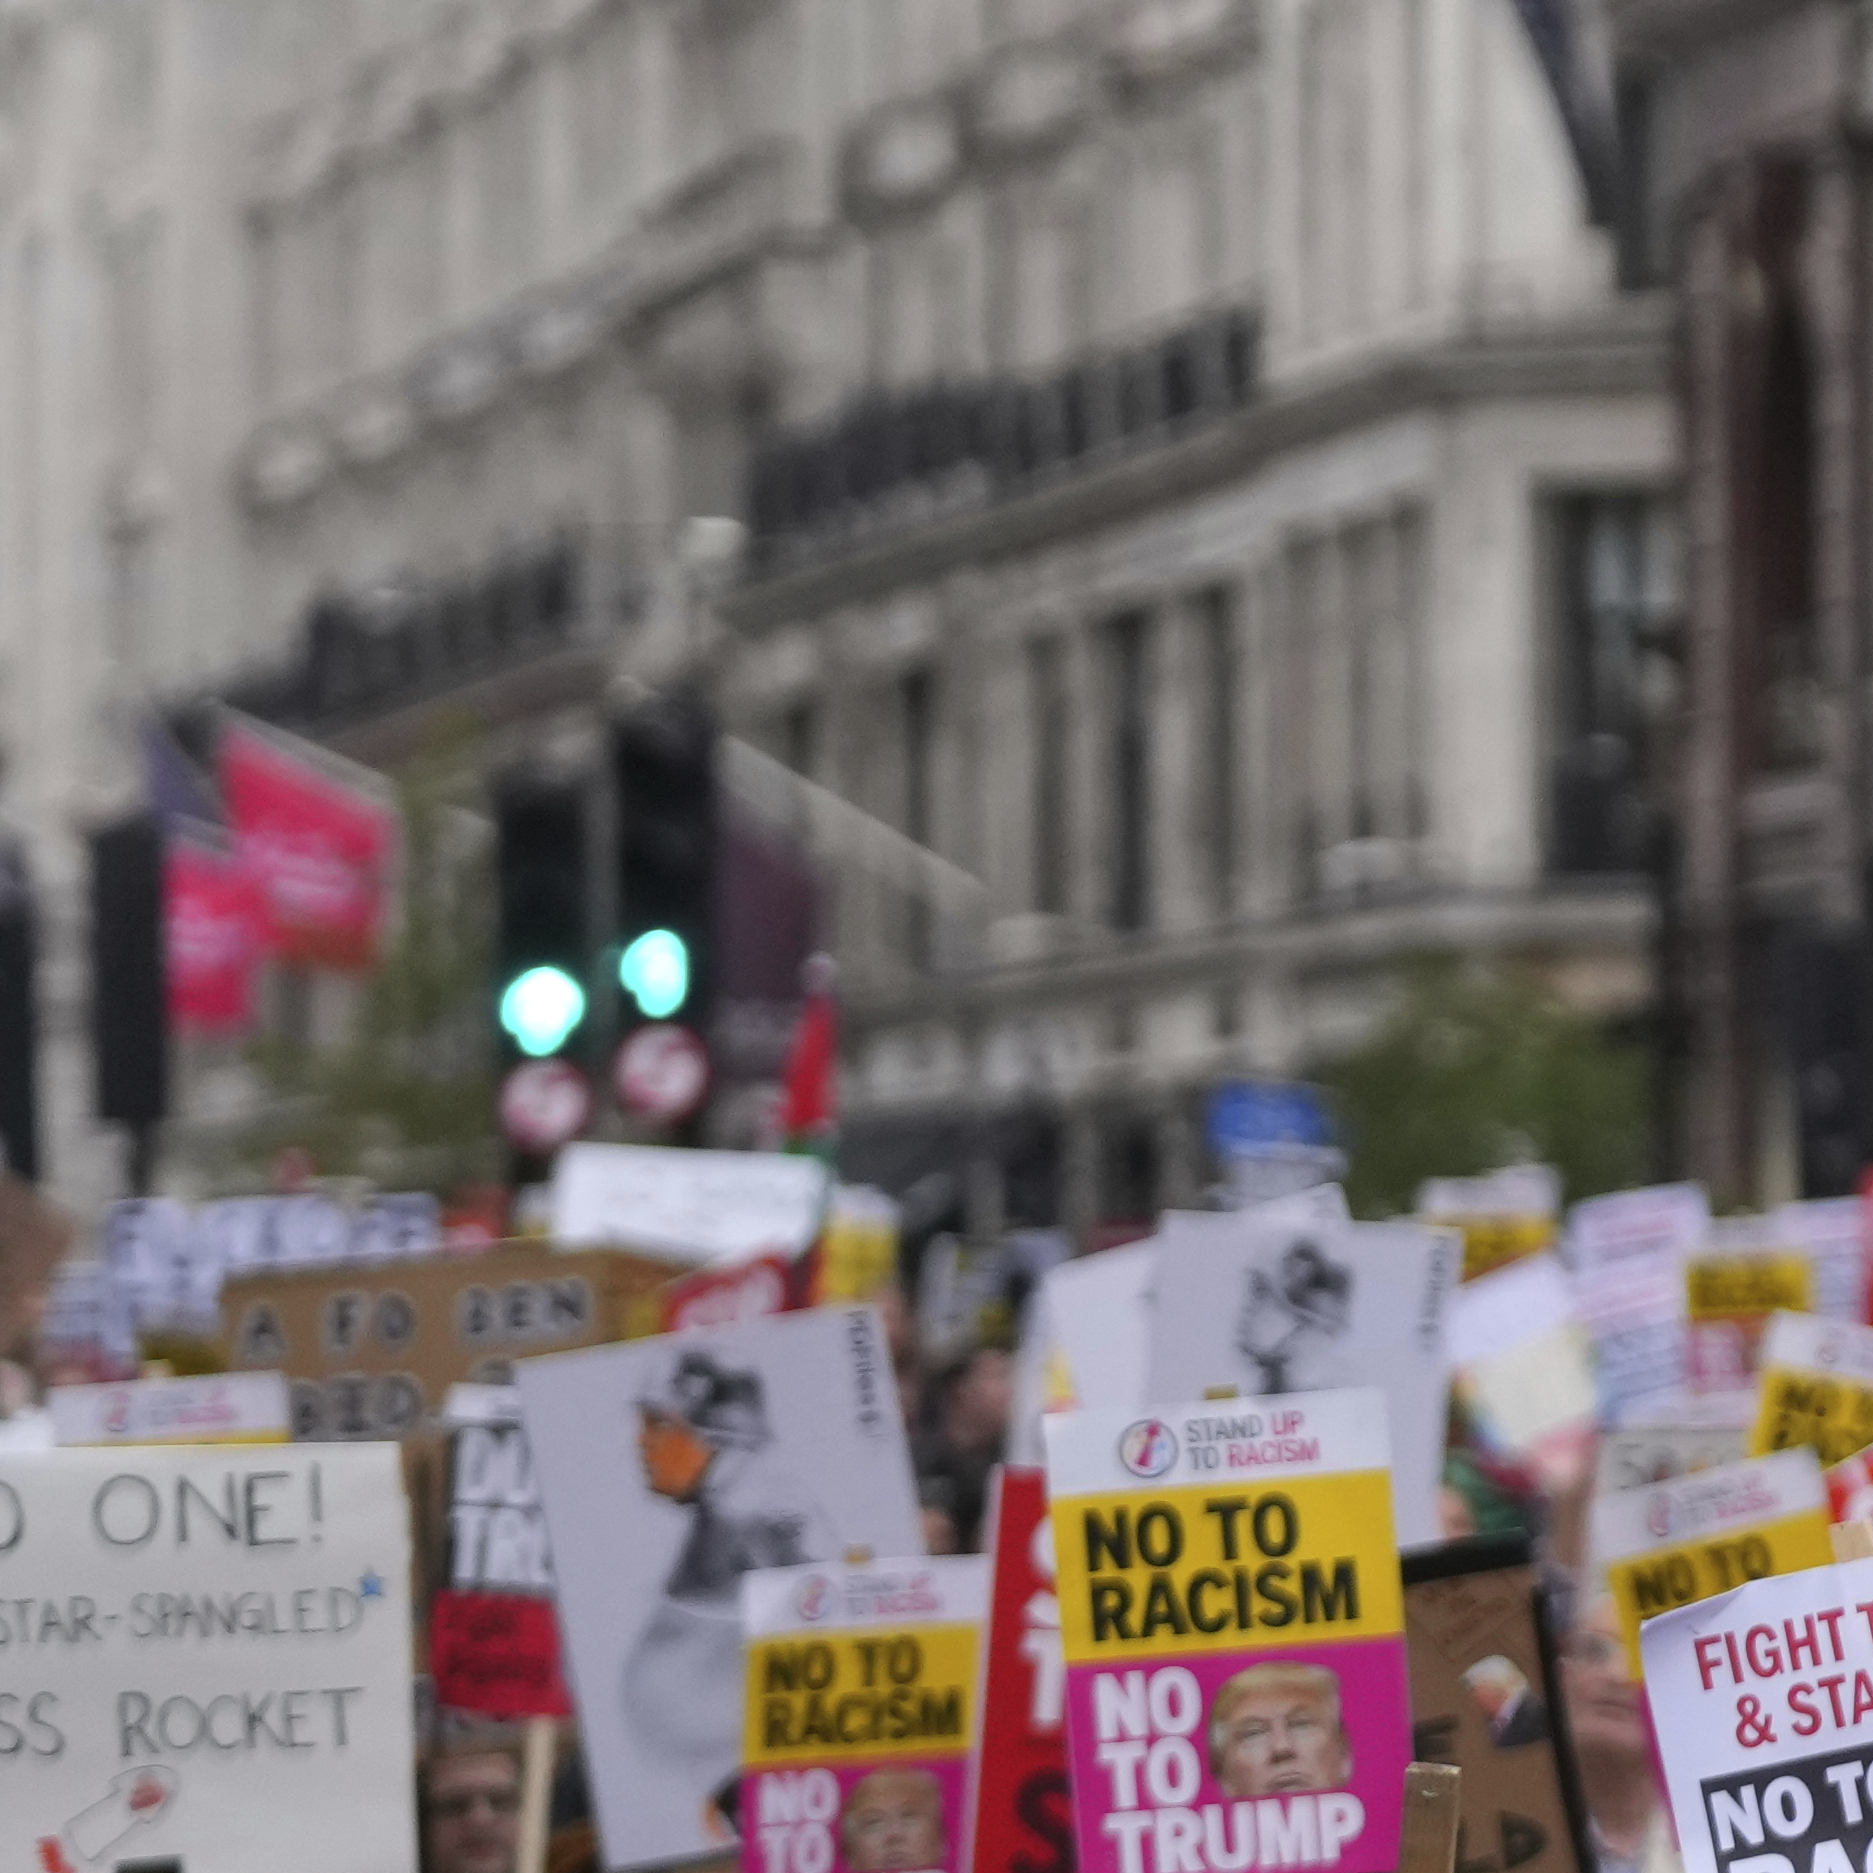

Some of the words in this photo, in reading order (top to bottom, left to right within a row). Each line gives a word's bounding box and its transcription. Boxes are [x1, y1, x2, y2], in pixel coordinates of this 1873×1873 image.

[1185, 1414, 1264, 1442] STAND
[1271, 1412, 1303, 1437] UP
[1188, 1445, 1221, 1471] TO
[1227, 1439, 1320, 1469] RACISM
[93, 1461, 323, 1547] ONE!
[1084, 1505, 1183, 1573] NO
[1204, 1495, 1298, 1561] TO
[1090, 1560, 1359, 1642] RACISM
[1630, 1551, 1699, 1611] NO
[1705, 1537, 1773, 1581] TO
[764, 1642, 835, 1692] NO
[854, 1638, 922, 1685] TO
[117, 1685, 365, 1757] ROCKET
[764, 1688, 961, 1749] RACISM
[1091, 1667, 1198, 1741] NO
[758, 1770, 839, 1826] NO
[1098, 1740, 1198, 1810] TO
[1711, 1776, 1813, 1852] NO
